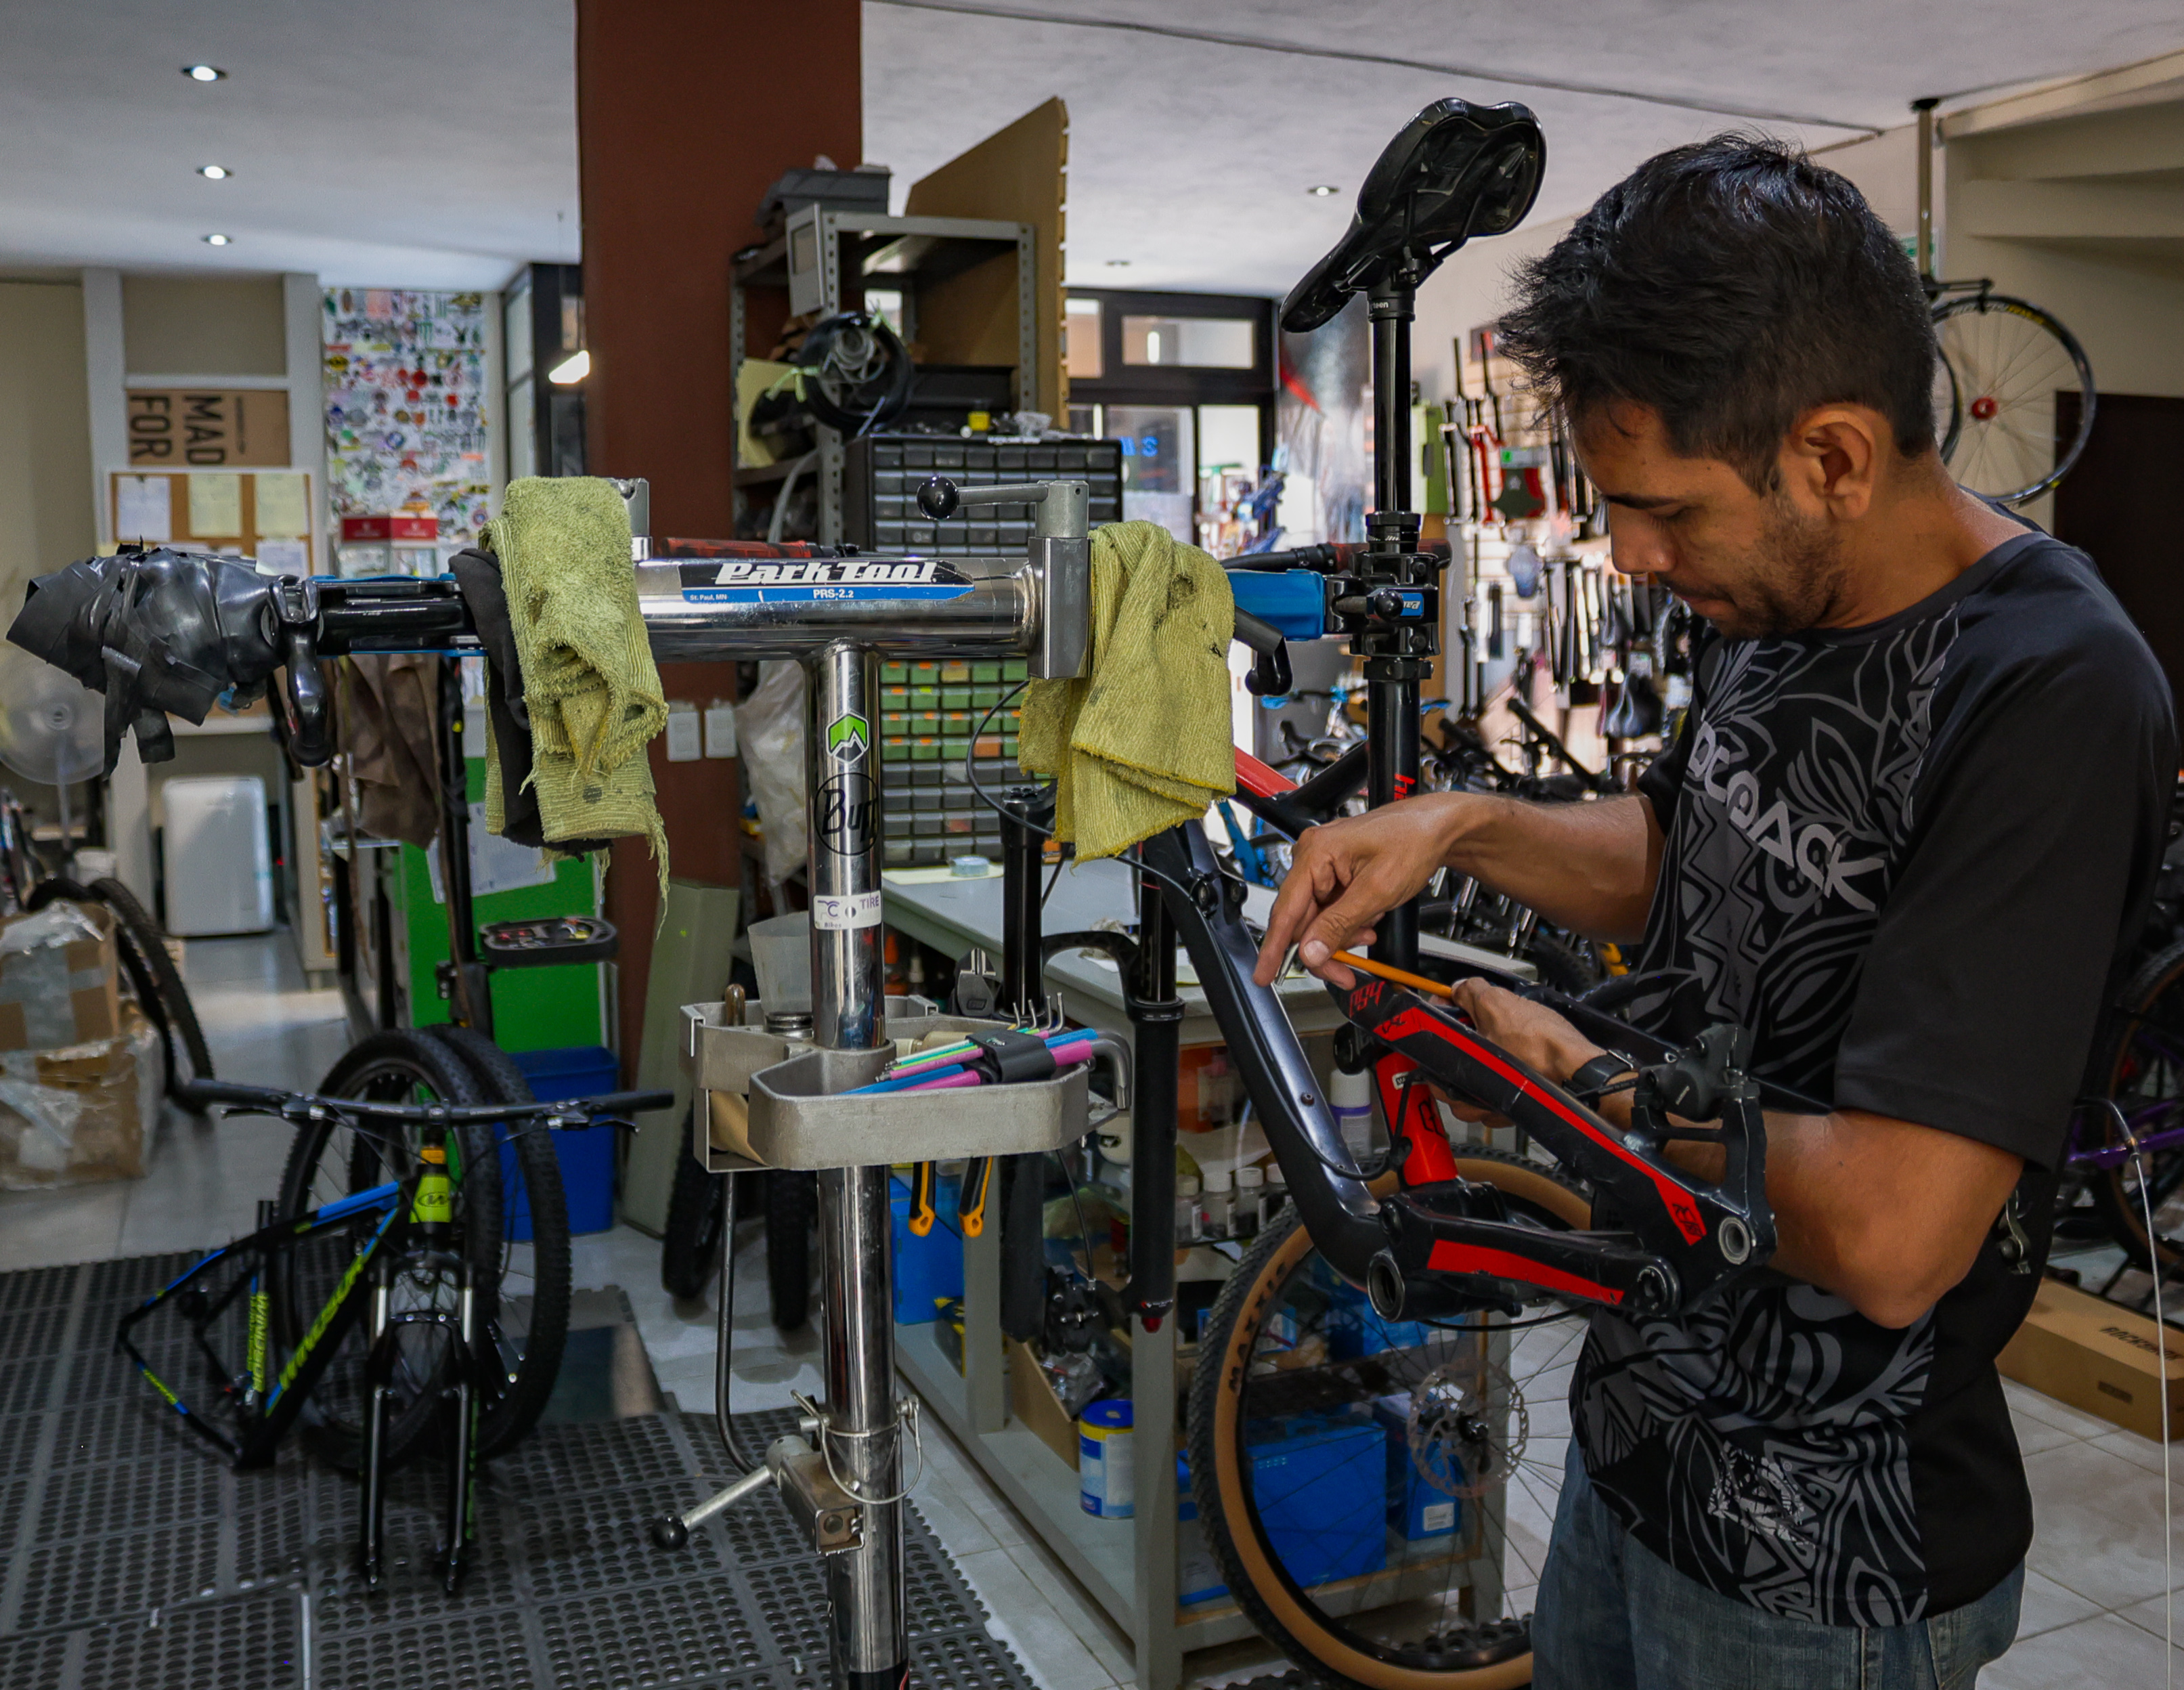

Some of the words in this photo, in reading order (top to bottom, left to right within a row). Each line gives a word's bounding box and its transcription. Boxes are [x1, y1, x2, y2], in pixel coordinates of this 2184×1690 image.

[130, 395, 171, 458] FOR
[183, 395, 225, 464] MAD
[813, 588, 854, 599] PRS-2.2
[860, 894, 879, 910] TIRE
